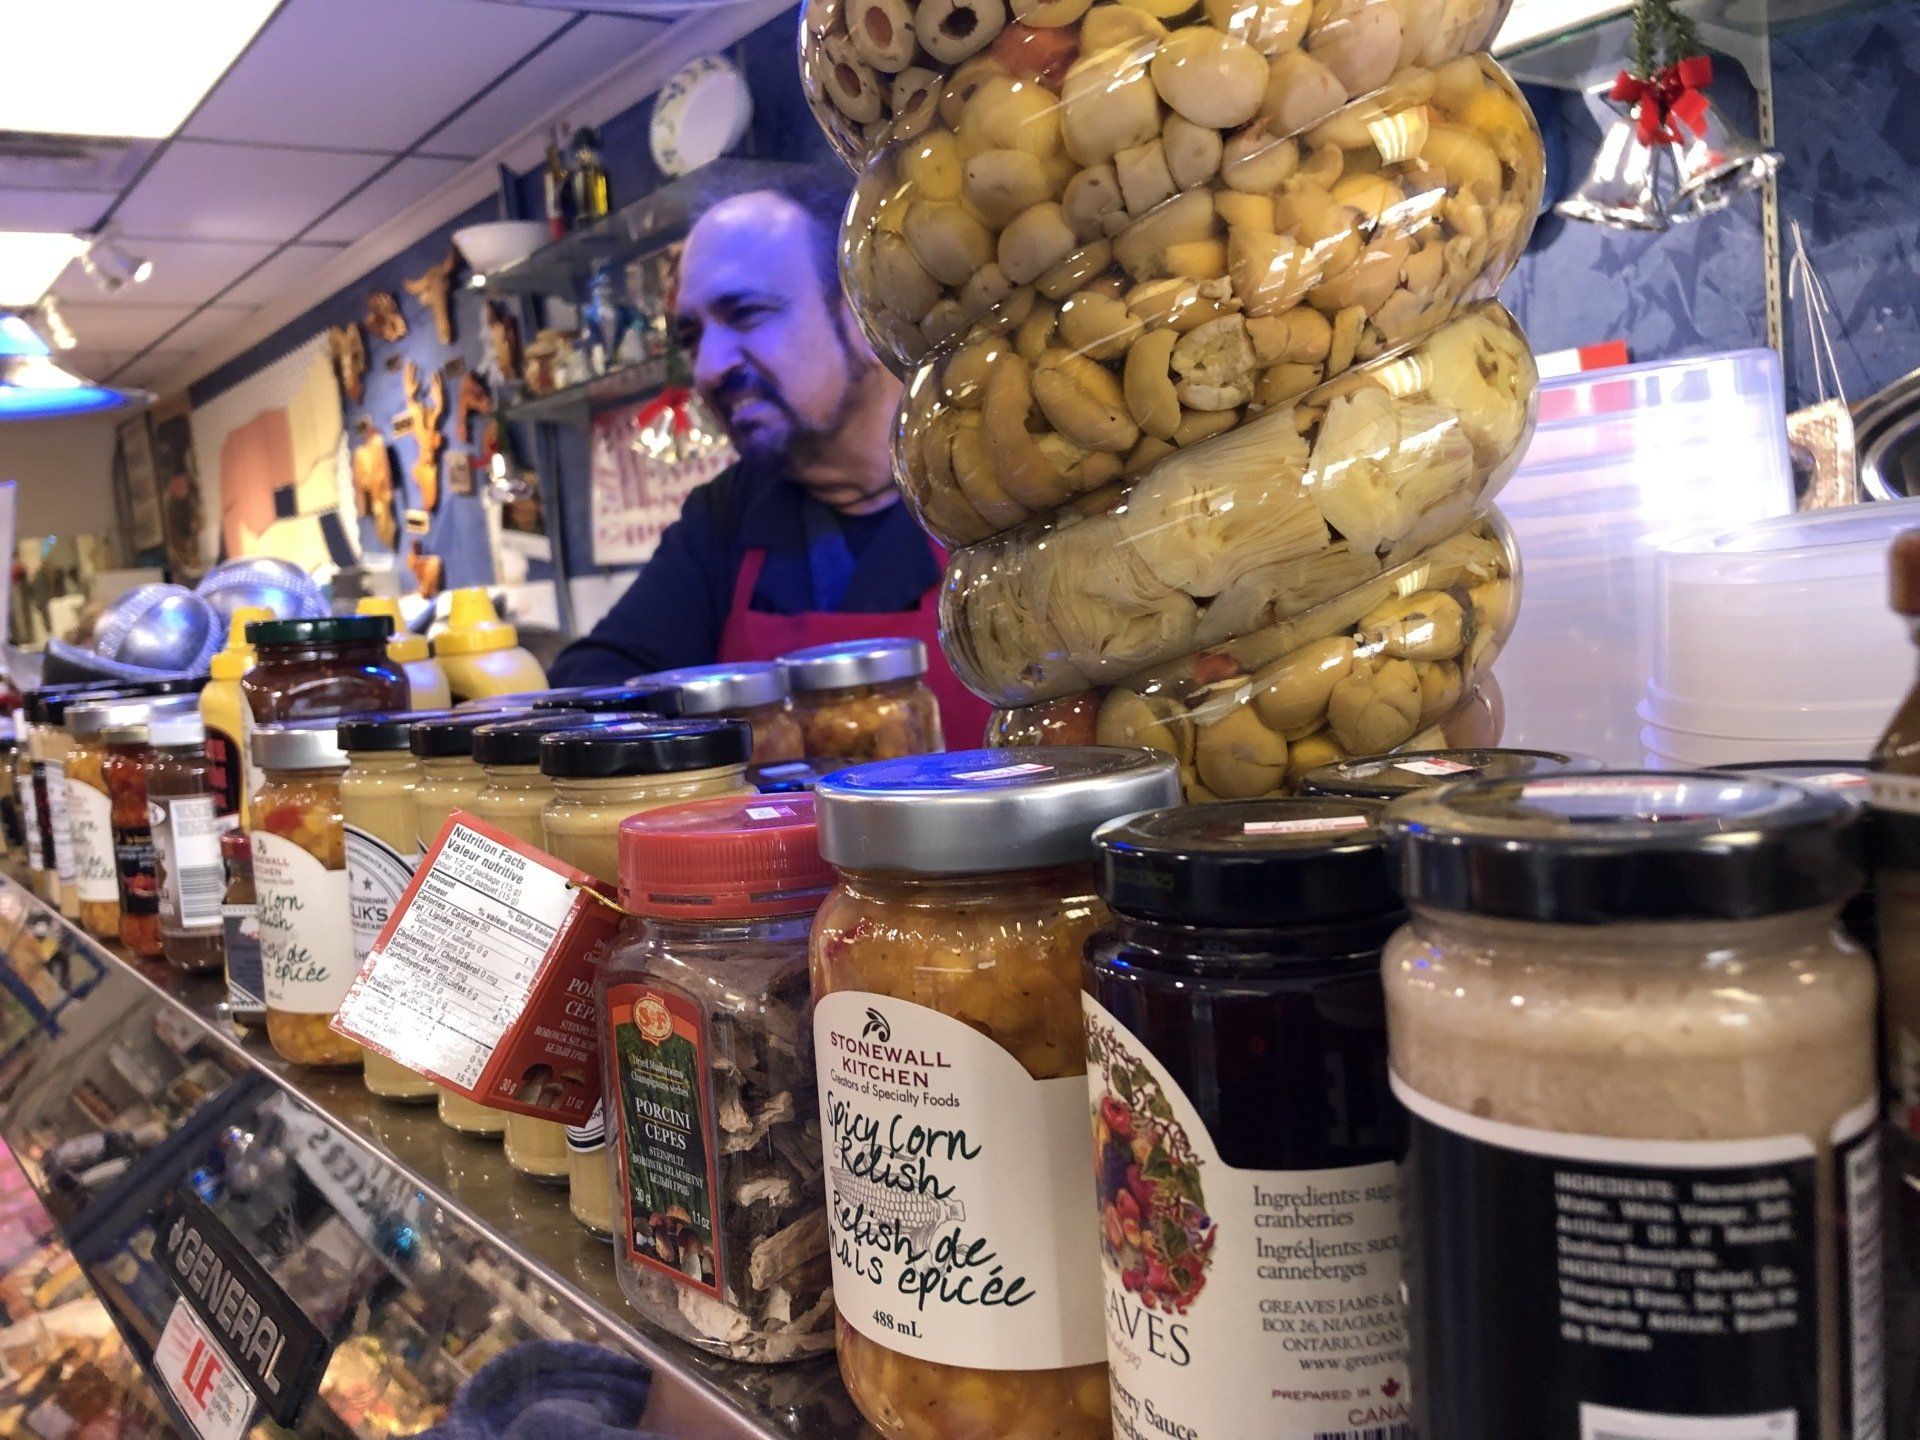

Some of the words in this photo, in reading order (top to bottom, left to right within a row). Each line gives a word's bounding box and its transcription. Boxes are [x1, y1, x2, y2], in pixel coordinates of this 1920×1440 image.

[447, 838, 480, 861] Valeur
[481, 857, 524, 885] nutritive
[453, 826, 498, 856] Nutrition
[499, 849, 526, 871] Facts
[429, 871, 456, 890] Amount
[435, 859, 452, 872] pour
[453, 867, 465, 878] 1/2
[464, 873, 475, 883] du
[475, 878, 498, 895] paquet
[440, 850, 452, 861] Per
[454, 857, 465, 868] 1/2
[473, 867, 501, 886] package
[423, 880, 448, 898] Teneur
[351, 903, 388, 922] LIK'S
[412, 901, 424, 912] Fat
[428, 910, 454, 928] Lipides
[414, 914, 448, 936] Saturated
[417, 891, 446, 911] Calories
[451, 908, 479, 928] Calories
[480, 922, 491, 933] 50
[514, 914, 533, 929] Daily
[534, 923, 554, 939] Value
[415, 925, 435, 941] Trans
[440, 936, 458, 951] trans
[486, 912, 508, 928] valeur
[508, 923, 549, 949] quotidienne
[390, 937, 418, 957] Sodium
[422, 953, 449, 973] Sodium
[396, 927, 437, 953] Cholesterol
[440, 949, 481, 975] Cholestérol
[830, 1031, 951, 1069] STONEWALL
[841, 1057, 929, 1088] KITCHEN
[830, 1069, 859, 1092] Creators
[861, 1080, 870, 1095] of
[872, 1084, 920, 1107] Specialty
[923, 1091, 960, 1108] Foods
[635, 1096, 691, 1130] PORCINI
[826, 1090, 879, 1151] Spicy
[889, 1114, 982, 1160] Corn
[645, 1121, 687, 1150] CÈPES
[840, 1135, 956, 1199] Relish
[635, 1187, 644, 1202] 30
[645, 1194, 652, 1208] g
[1253, 1184, 1361, 1212] Ingredients:
[832, 1189, 927, 1266] Relish
[936, 1227, 997, 1269] de
[1254, 1206, 1354, 1228] cranberries
[1257, 1260, 1368, 1283] canneberges
[175, 1227, 286, 1396] GENERAL
[1259, 1298, 1335, 1314] GREAVES
[1338, 1294, 1379, 1315] JAMS
[872, 1309, 895, 1331] 488
[897, 1319, 923, 1340] mL
[1108, 1287, 1191, 1367] AVES
[1262, 1317, 1296, 1333] BOX
[1366, 1328, 1401, 1347] CAN
[1272, 1389, 1352, 1401] PREPARED
[1357, 1387, 1370, 1397] IN
[1145, 1398, 1198, 1440] Sauce
[1348, 1401, 1409, 1426] CANA
